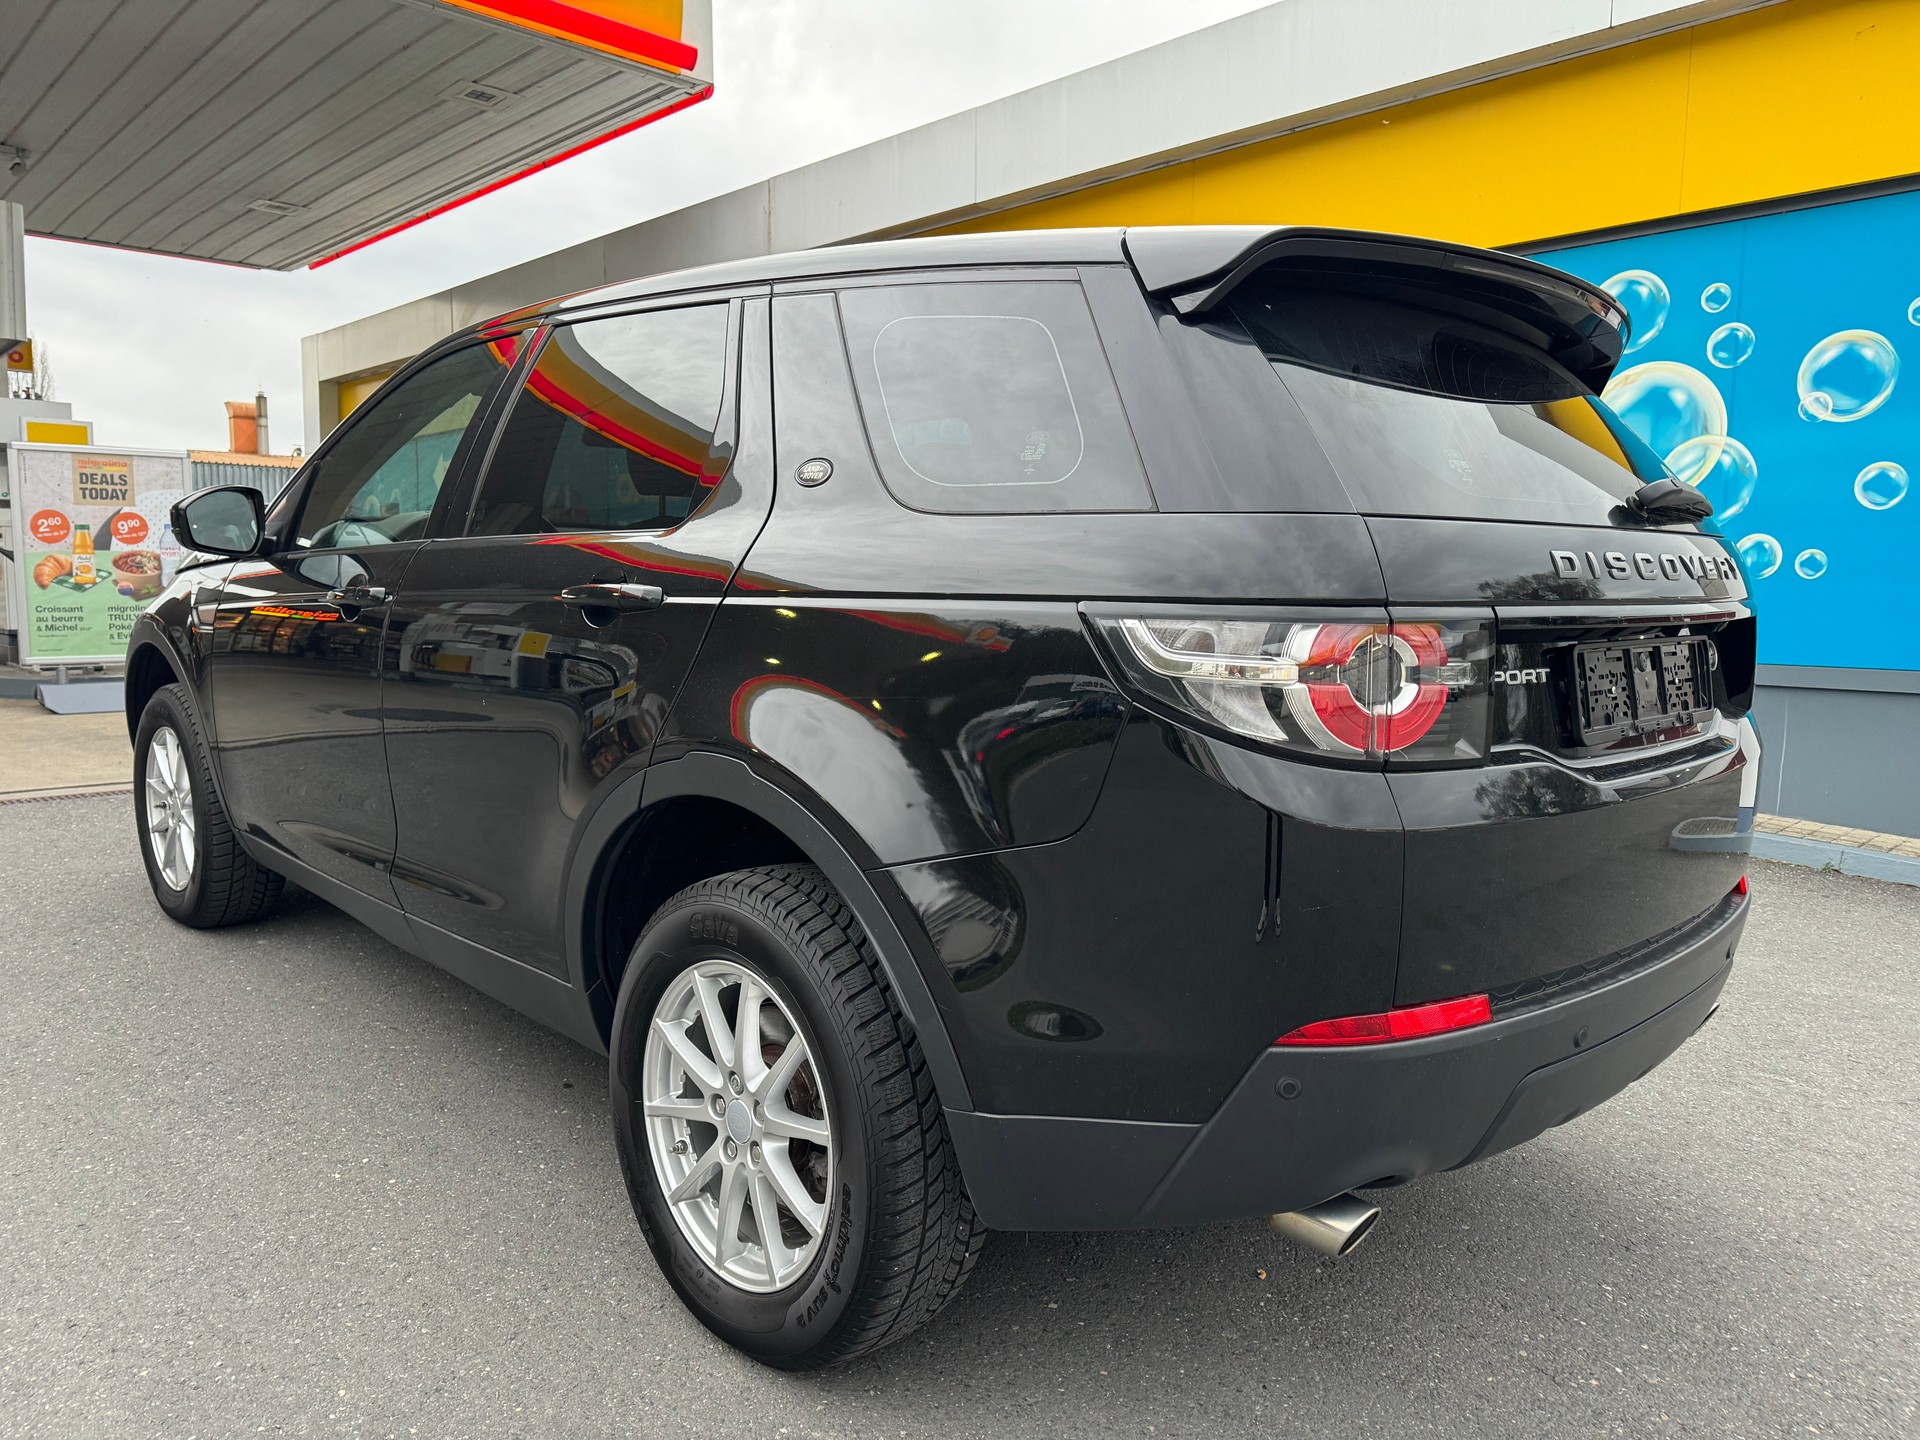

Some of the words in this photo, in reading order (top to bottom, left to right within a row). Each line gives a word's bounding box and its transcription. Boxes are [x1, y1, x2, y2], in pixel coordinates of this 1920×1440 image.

[79, 472, 128, 486] DEALS
[79, 487, 128, 501] TODAY
[1550, 550, 1738, 581] DISCOVERY
[35, 605, 84, 613] Croissant
[51, 614, 84, 622] beurre
[45, 624, 77, 632] Michel
